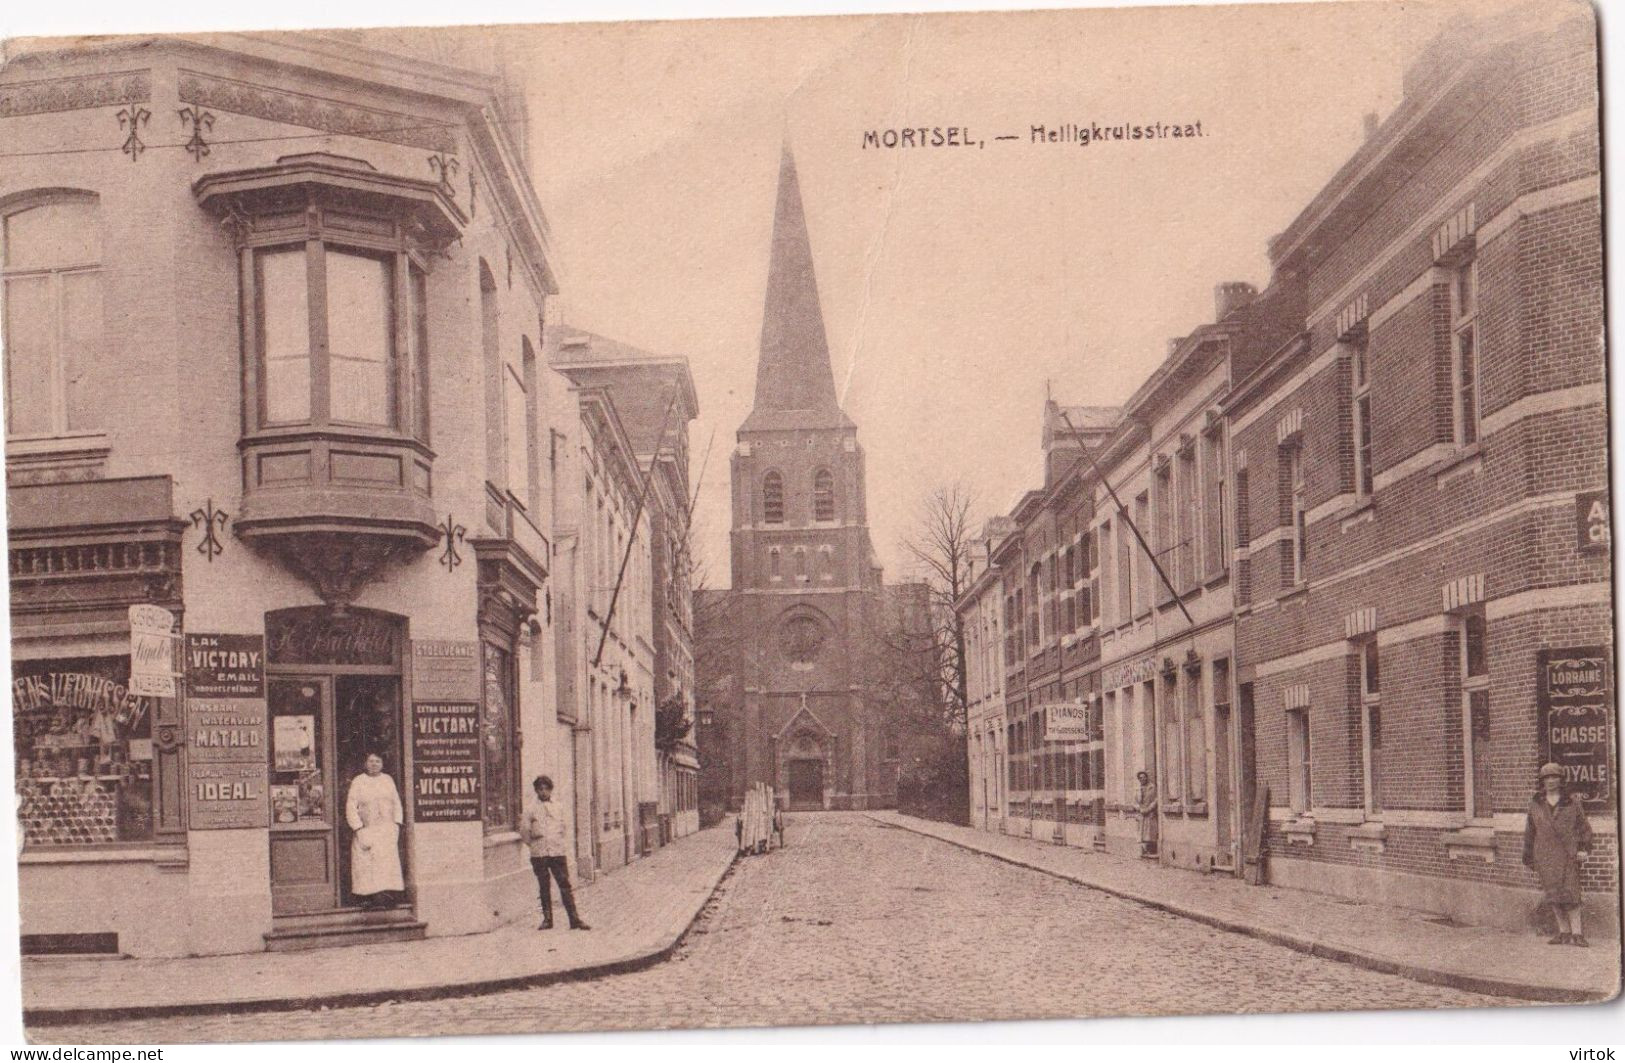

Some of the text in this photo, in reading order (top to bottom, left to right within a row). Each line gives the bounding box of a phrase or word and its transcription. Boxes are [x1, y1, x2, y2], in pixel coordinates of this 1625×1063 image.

[191, 637, 219, 647] LAK
[193, 650, 259, 669] VICTORY
[217, 672, 261, 682] EMAIL
[1552, 669, 1601, 685] LORRAINE
[419, 717, 476, 734] VICTORY
[1552, 725, 1605, 744] CHASSE
[197, 782, 257, 800] IDEAL
[419, 777, 478, 795] VICTORY
